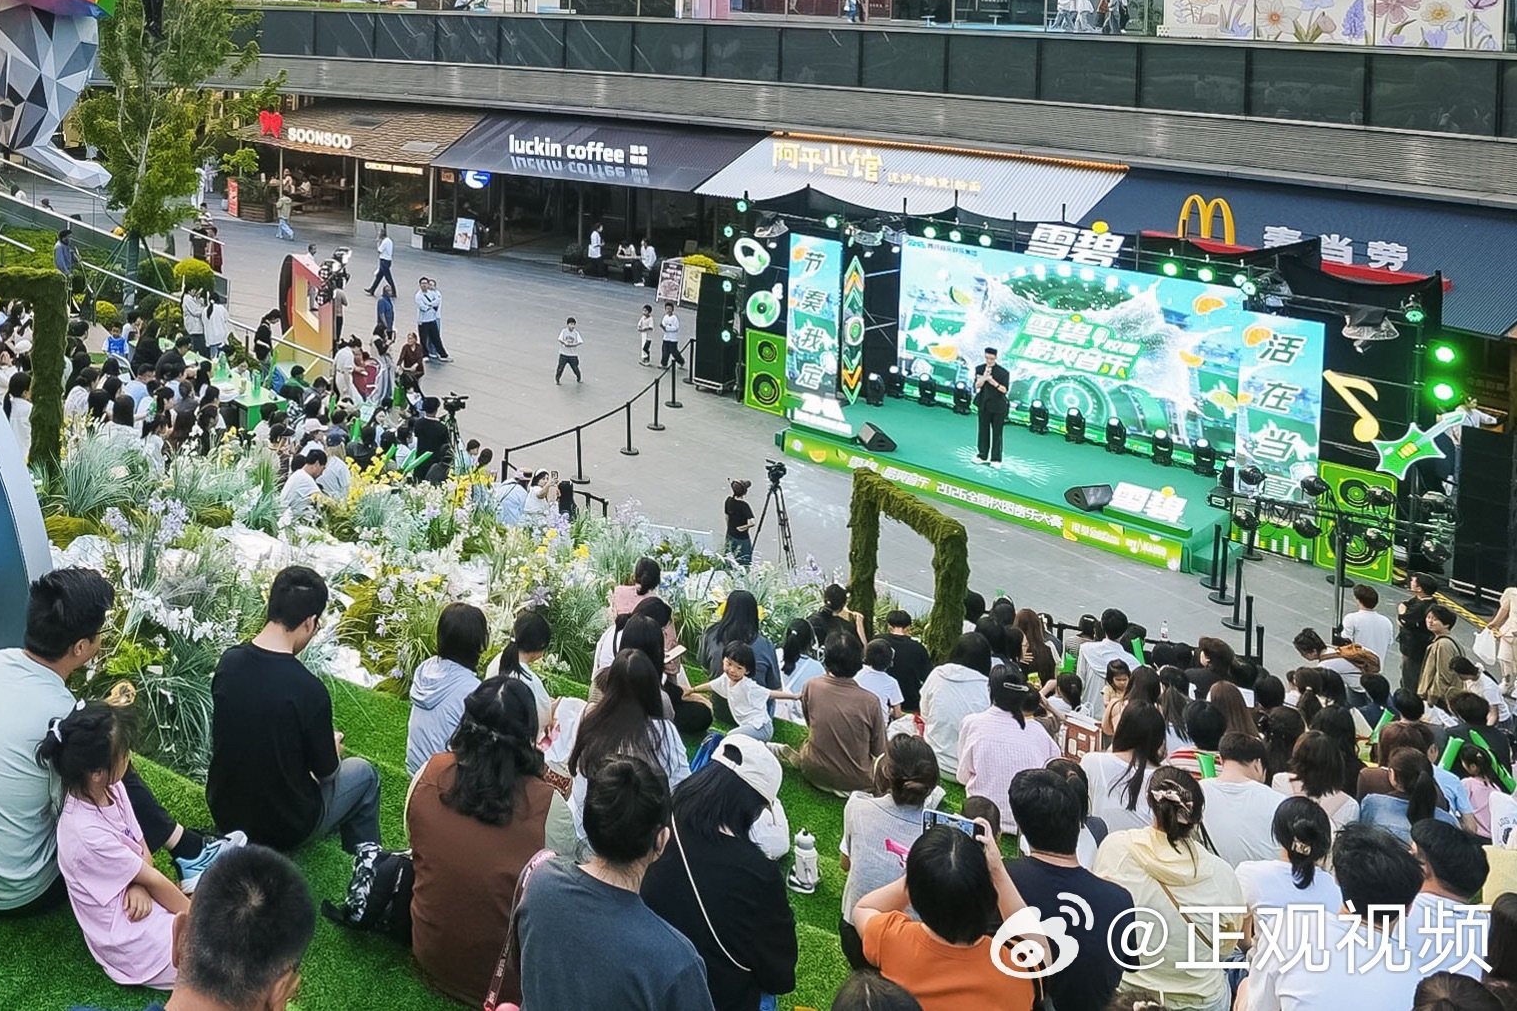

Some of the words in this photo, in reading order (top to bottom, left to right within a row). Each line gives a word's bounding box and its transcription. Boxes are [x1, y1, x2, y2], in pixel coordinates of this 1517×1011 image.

[287, 127, 352, 150] SOONSOO
[509, 134, 562, 158] luckin
[566, 141, 625, 164] coffee
[772, 142, 883, 183] 阿平小馆
[1024, 222, 1125, 268] 雪碧
[796, 251, 826, 387] 节奏我定
[1025, 312, 1094, 346] 雪碧
[1111, 481, 1188, 524] 雪碧
